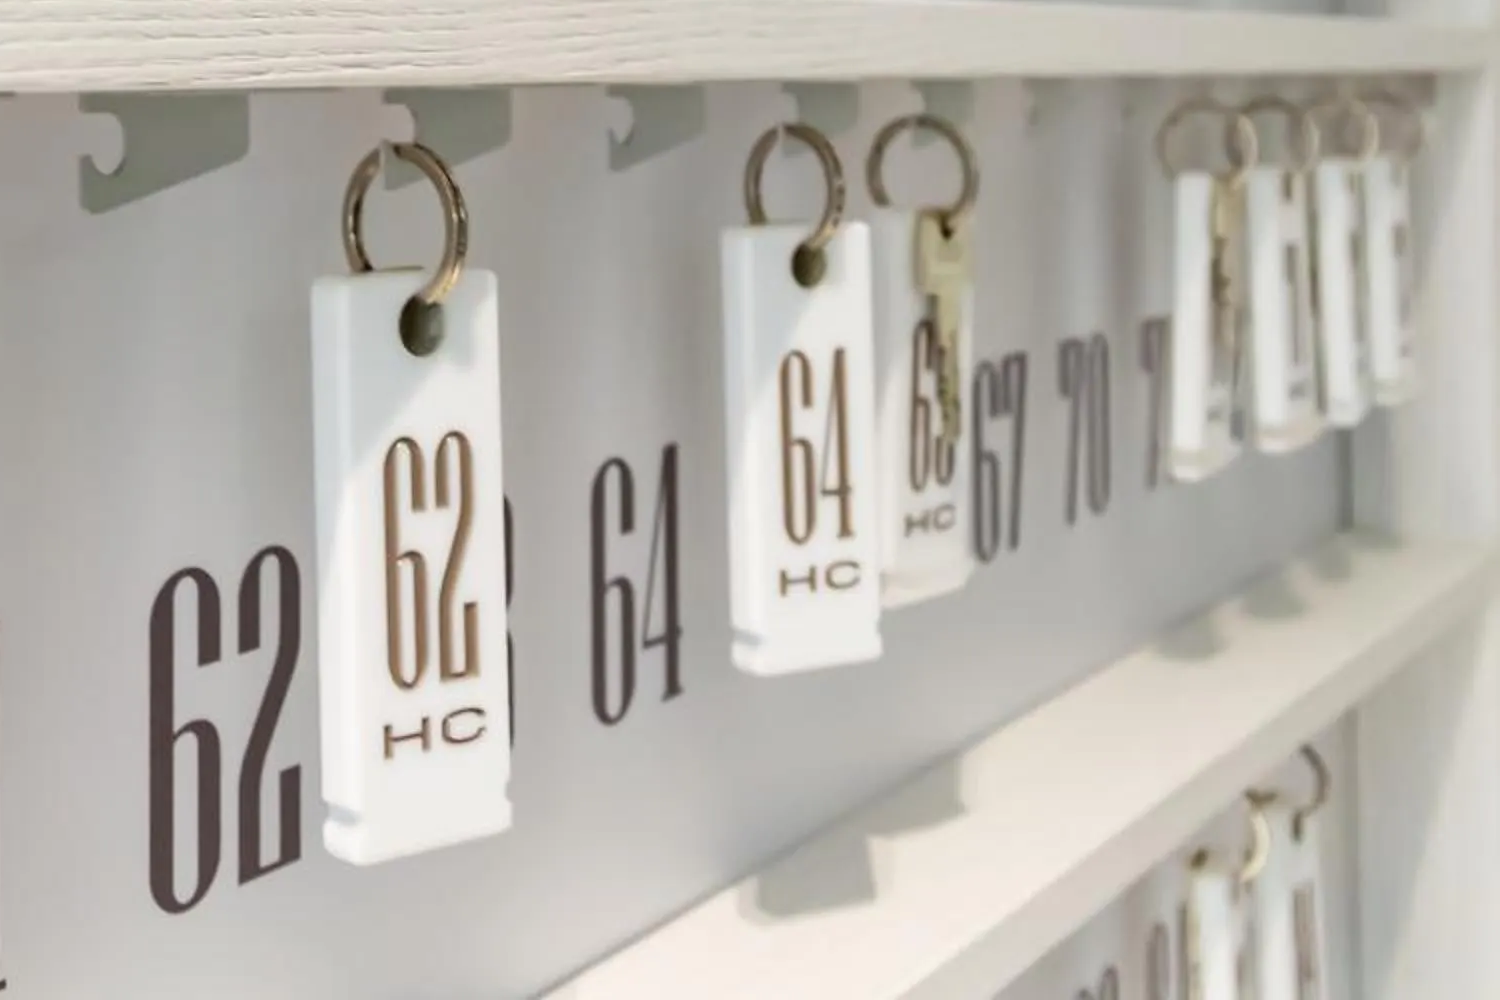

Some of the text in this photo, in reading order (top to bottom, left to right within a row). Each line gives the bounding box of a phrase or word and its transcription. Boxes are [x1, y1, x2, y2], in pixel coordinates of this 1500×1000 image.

[778, 347, 854, 546] 64
[148, 544, 302, 914] 62
[590, 442, 683, 726] 64
[971, 351, 1028, 563] 67
[382, 429, 479, 690] 62
[778, 559, 861, 597] HC
[383, 706, 486, 760] HC
